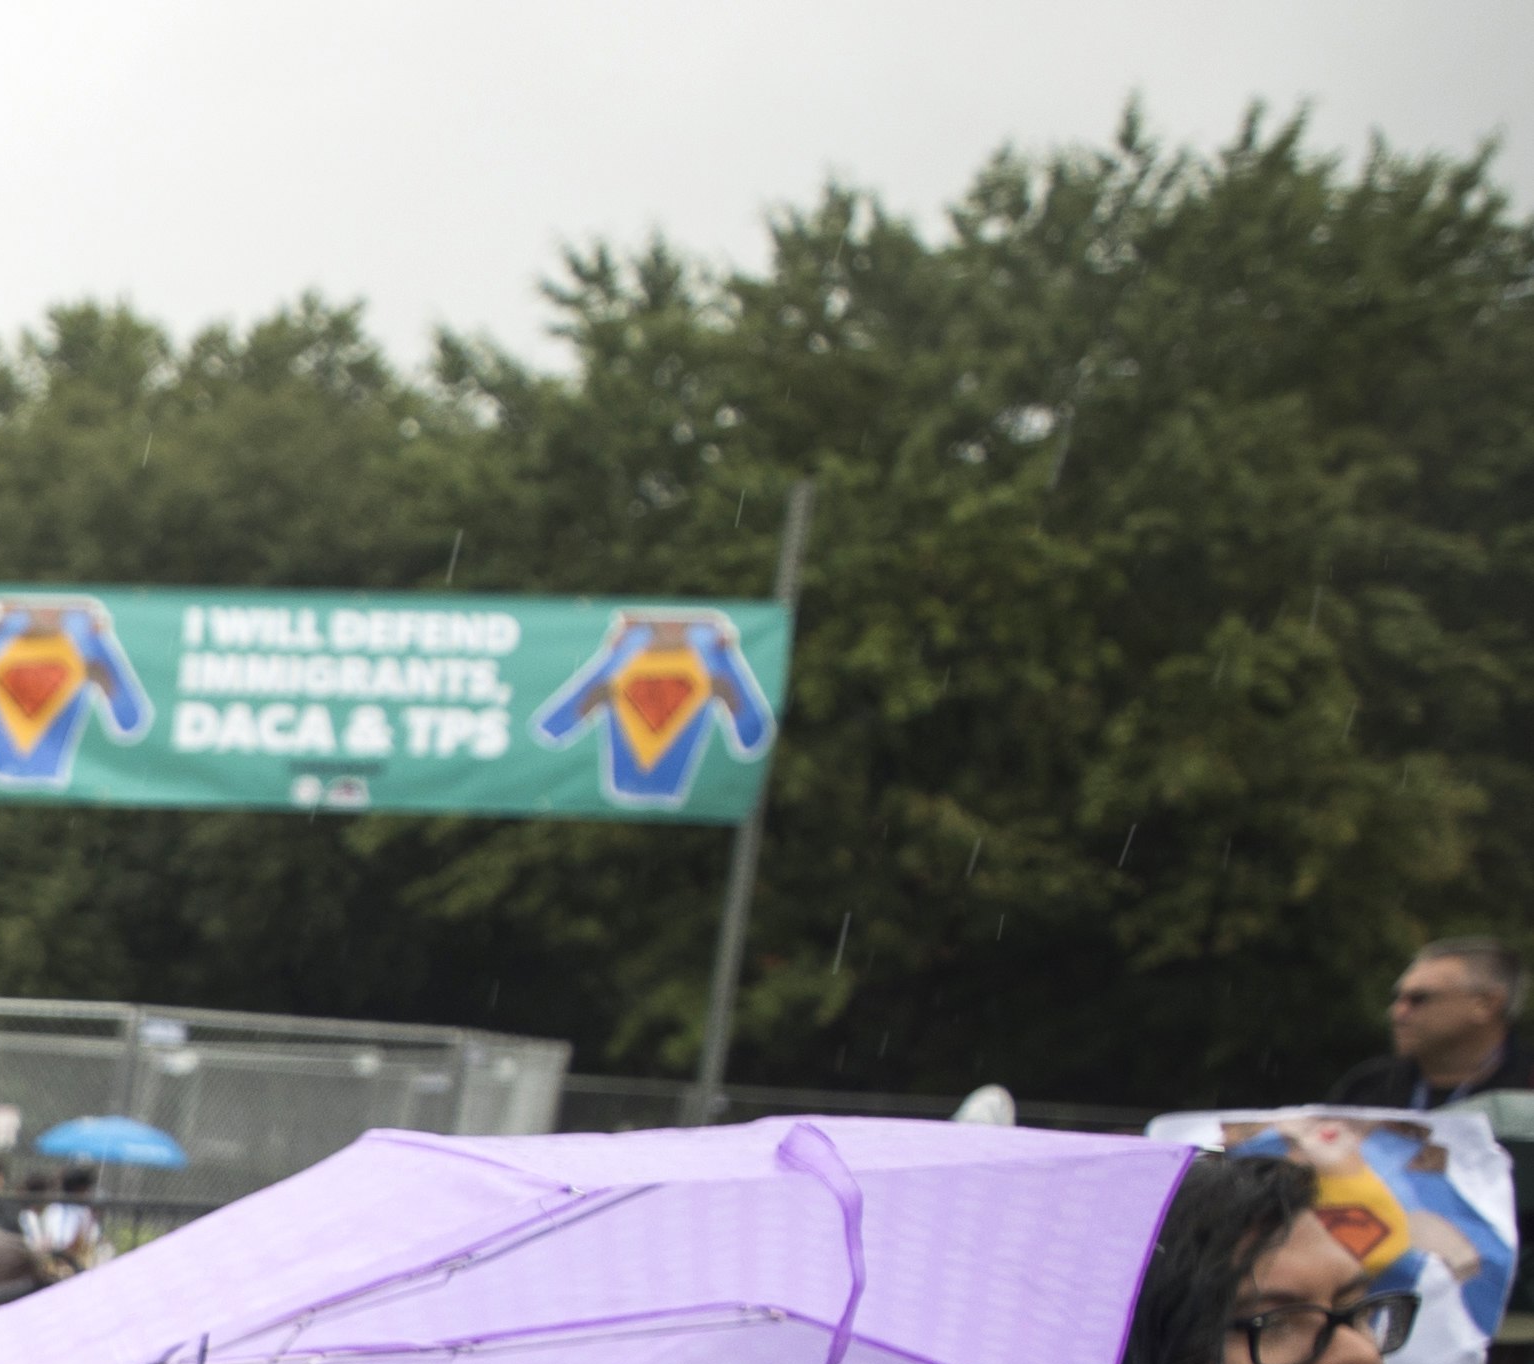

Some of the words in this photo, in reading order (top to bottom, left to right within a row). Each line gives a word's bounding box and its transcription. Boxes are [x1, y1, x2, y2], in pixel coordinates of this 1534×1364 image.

[183, 605, 204, 648] I
[211, 606, 323, 649] WILL
[330, 607, 521, 656] DEFEND
[179, 652, 512, 706] IMMIGRANTS,
[174, 700, 337, 754] DACA
[343, 703, 394, 756] &
[402, 706, 511, 760] TPS
